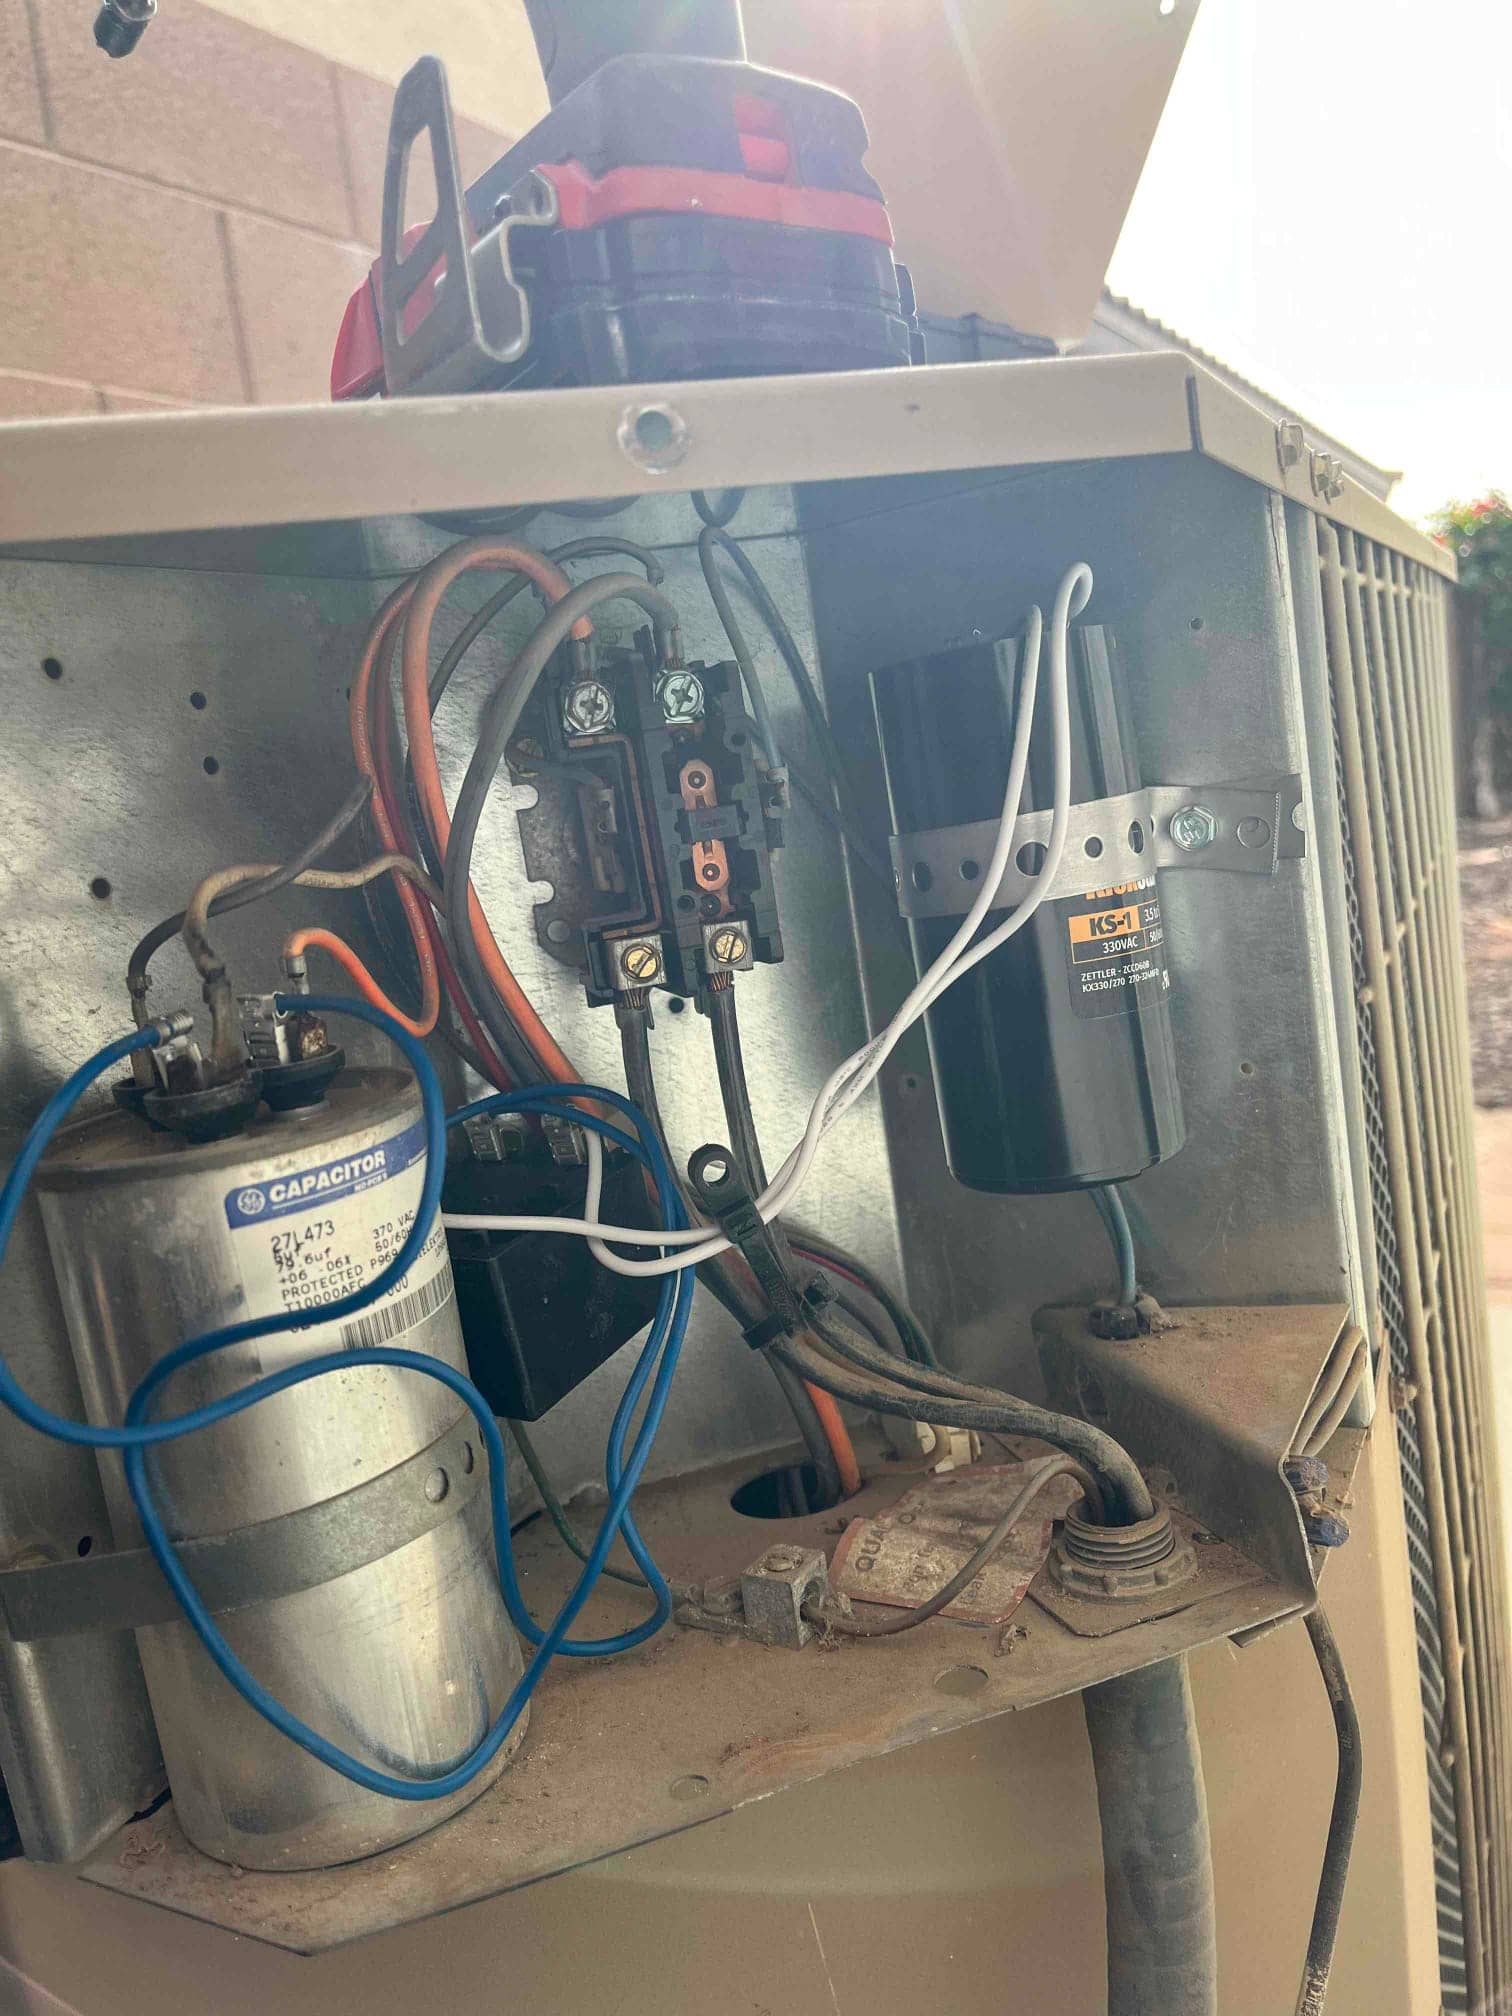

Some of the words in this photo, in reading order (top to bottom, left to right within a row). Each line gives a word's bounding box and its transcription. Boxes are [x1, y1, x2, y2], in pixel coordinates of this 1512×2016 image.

[1089, 912, 1132, 937] KS-1
[1102, 936, 1138, 954] 330VAC
[1081, 967, 1116, 982] ZETTLER
[1082, 977, 1126, 993] KX330/270
[269, 1150, 386, 1203] CAPACITOR
[372, 1222, 394, 1240] 370
[397, 1209, 415, 1227] VAC
[375, 1227, 413, 1252] 50/60H
[279, 1269, 308, 1286] +06
[282, 1264, 363, 1300] PROTECTED
